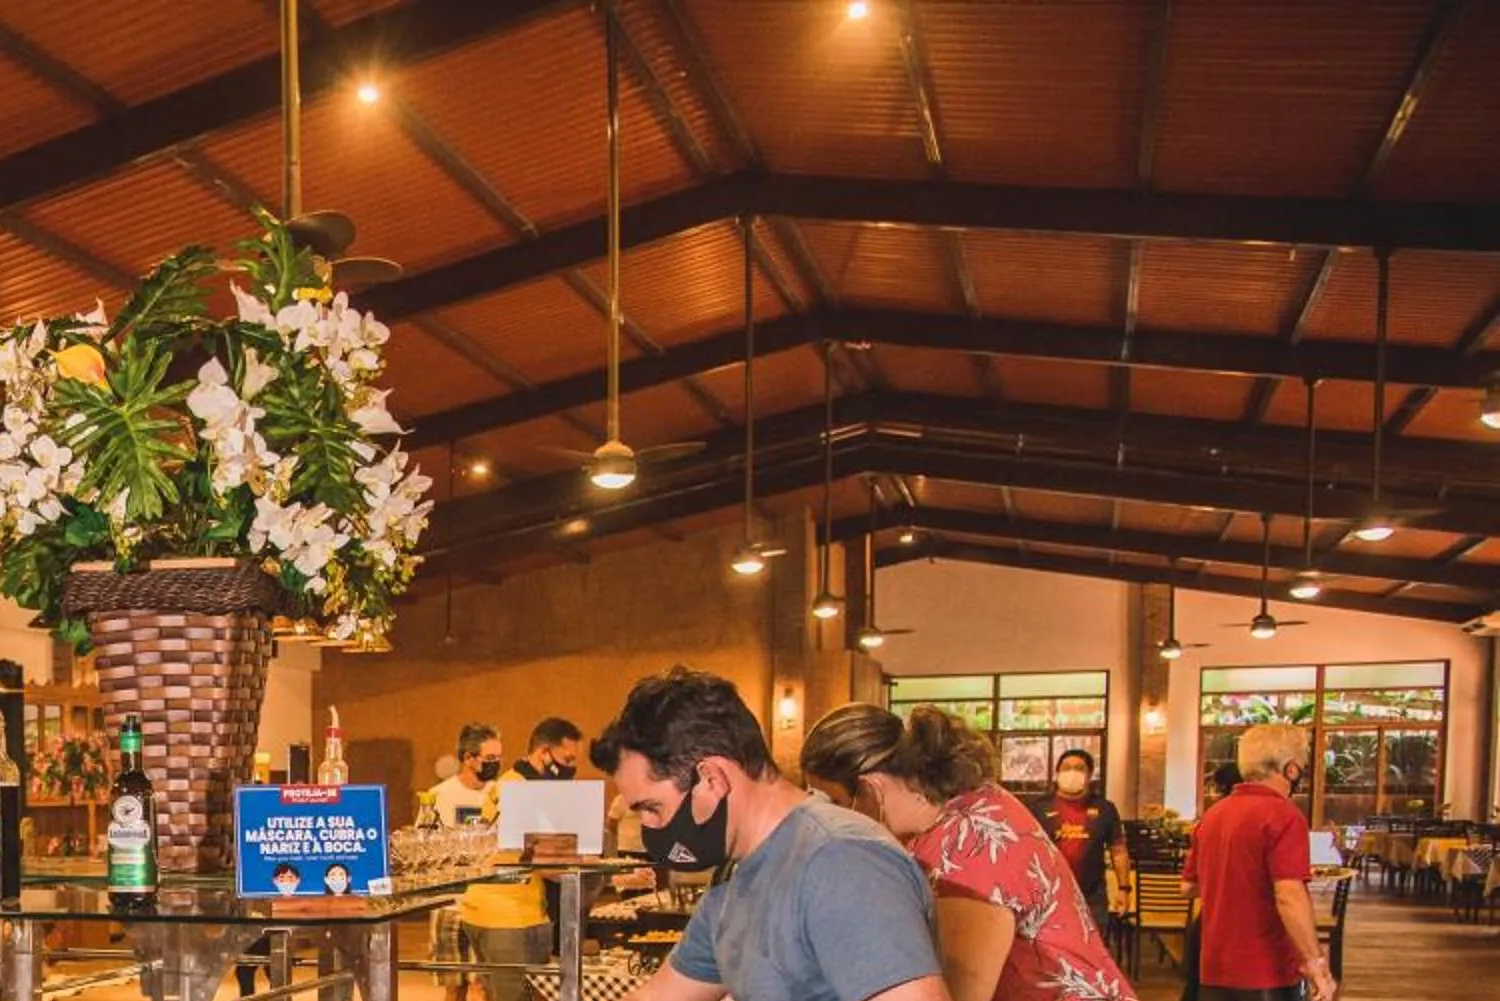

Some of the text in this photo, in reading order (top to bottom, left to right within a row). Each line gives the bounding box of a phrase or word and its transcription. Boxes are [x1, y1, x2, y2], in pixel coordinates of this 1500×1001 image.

[267, 816, 355, 829] UTILIZE A SUA
[245, 826, 377, 842] MÁSCARA, CUBRA O
[260, 841, 367, 855] NARIZ E A BOCA.
